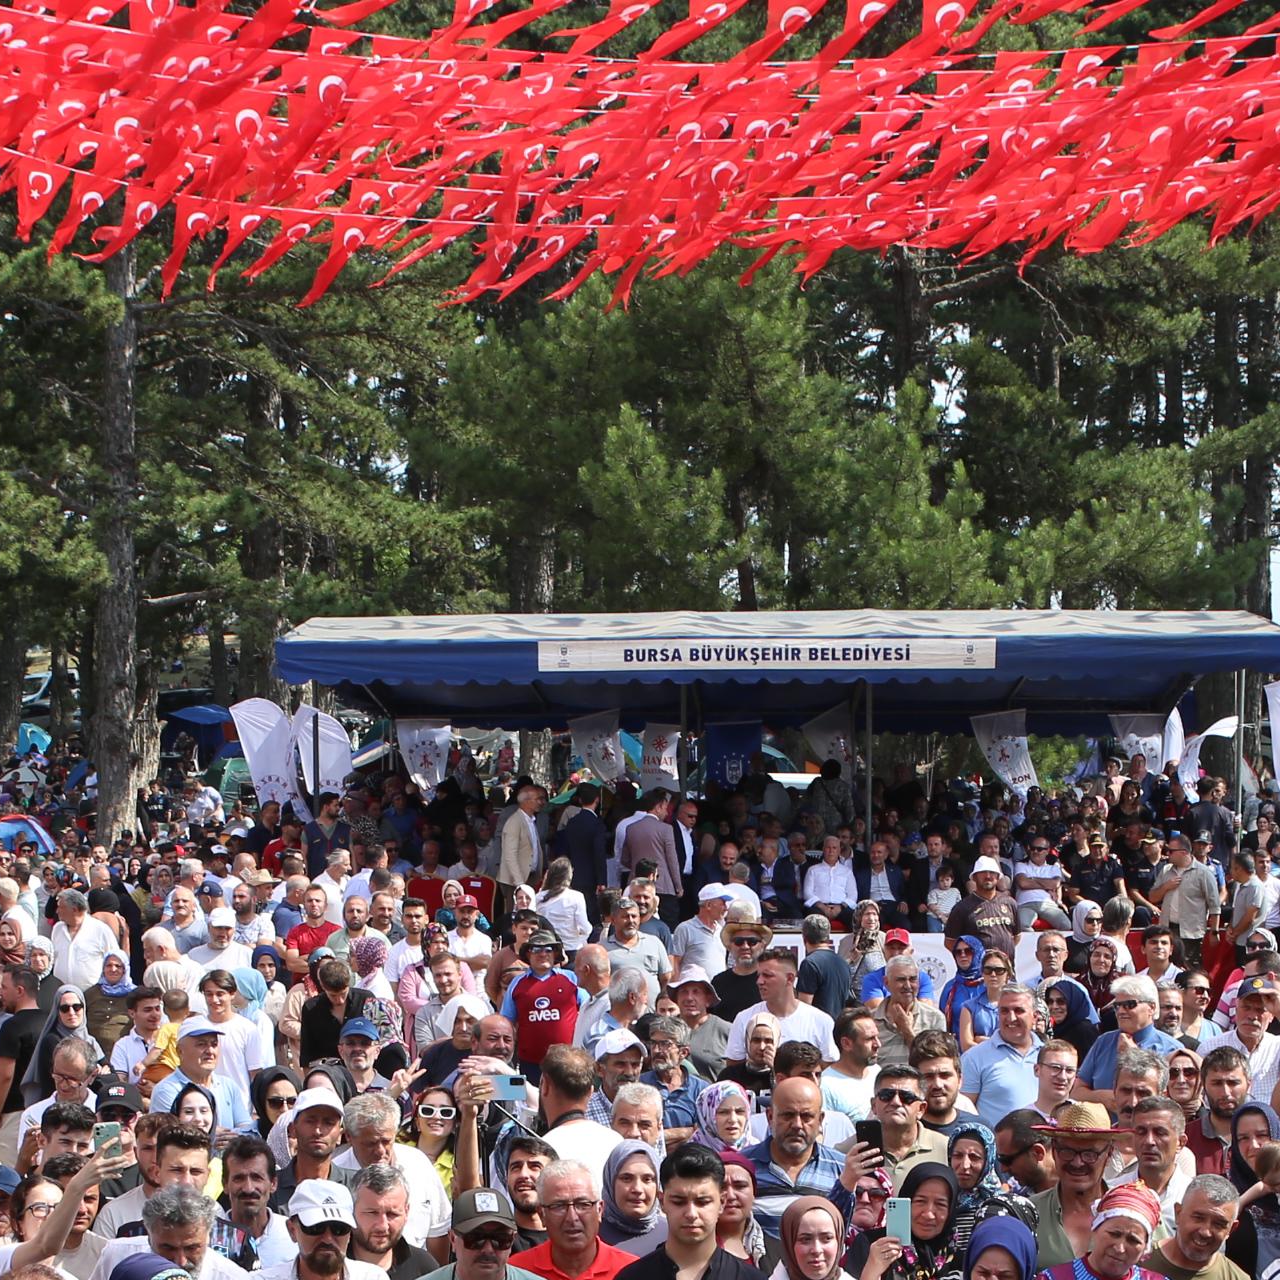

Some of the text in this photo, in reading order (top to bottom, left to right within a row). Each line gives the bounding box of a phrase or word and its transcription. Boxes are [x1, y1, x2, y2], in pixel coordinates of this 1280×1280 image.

[623, 644, 911, 665] BURSA BÜYÜKŞEHİR BELEDİYESİ
[643, 755, 674, 765] HAYAT
[528, 1008, 560, 1022] avea
